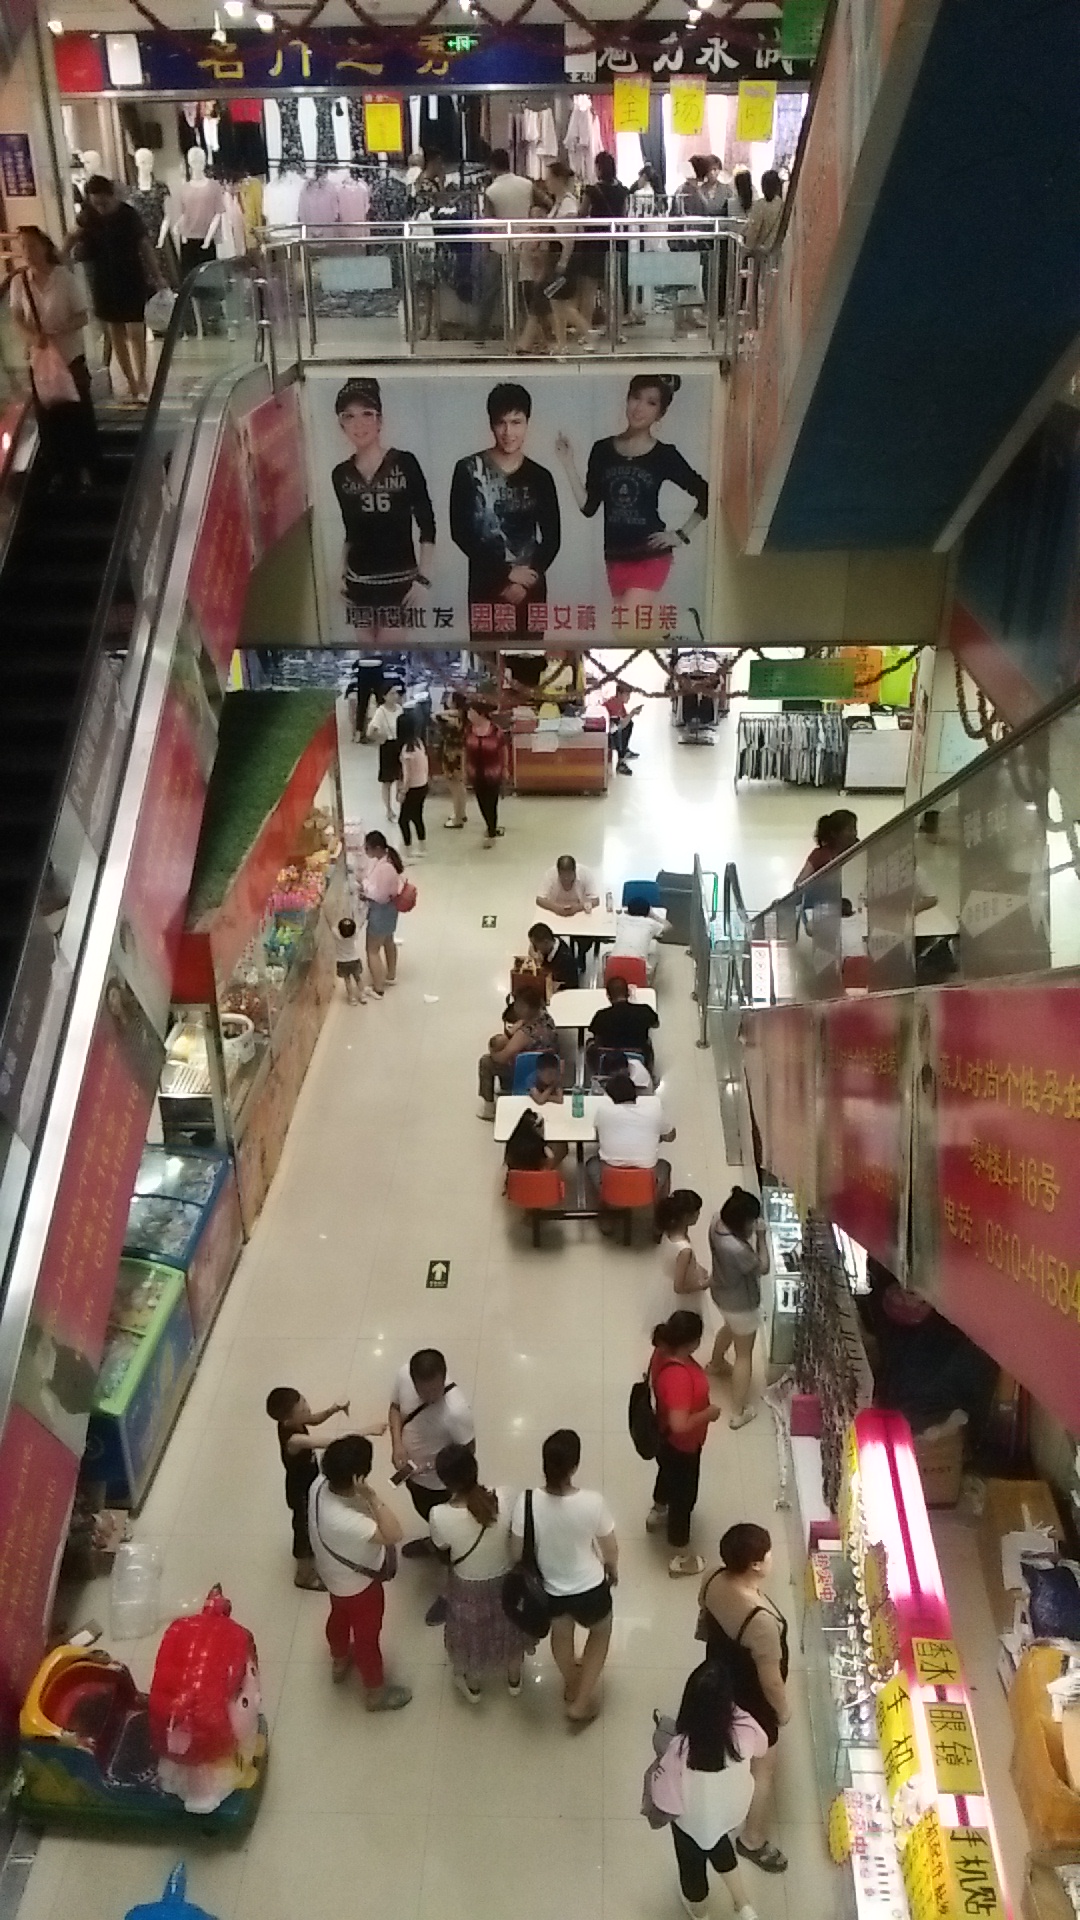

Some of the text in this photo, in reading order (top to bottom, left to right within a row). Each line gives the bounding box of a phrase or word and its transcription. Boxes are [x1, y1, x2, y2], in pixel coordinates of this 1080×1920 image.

[341, 475, 407, 494] CARLINA
[361, 493, 391, 512] 36
[471, 604, 516, 632] 男装
[528, 604, 595, 632] 男女裤
[611, 605, 677, 630] 牛仔装
[915, 1641, 957, 1682] 香水
[929, 1708, 973, 1769] 眼镜
[949, 1829, 997, 1917] 手机贴
